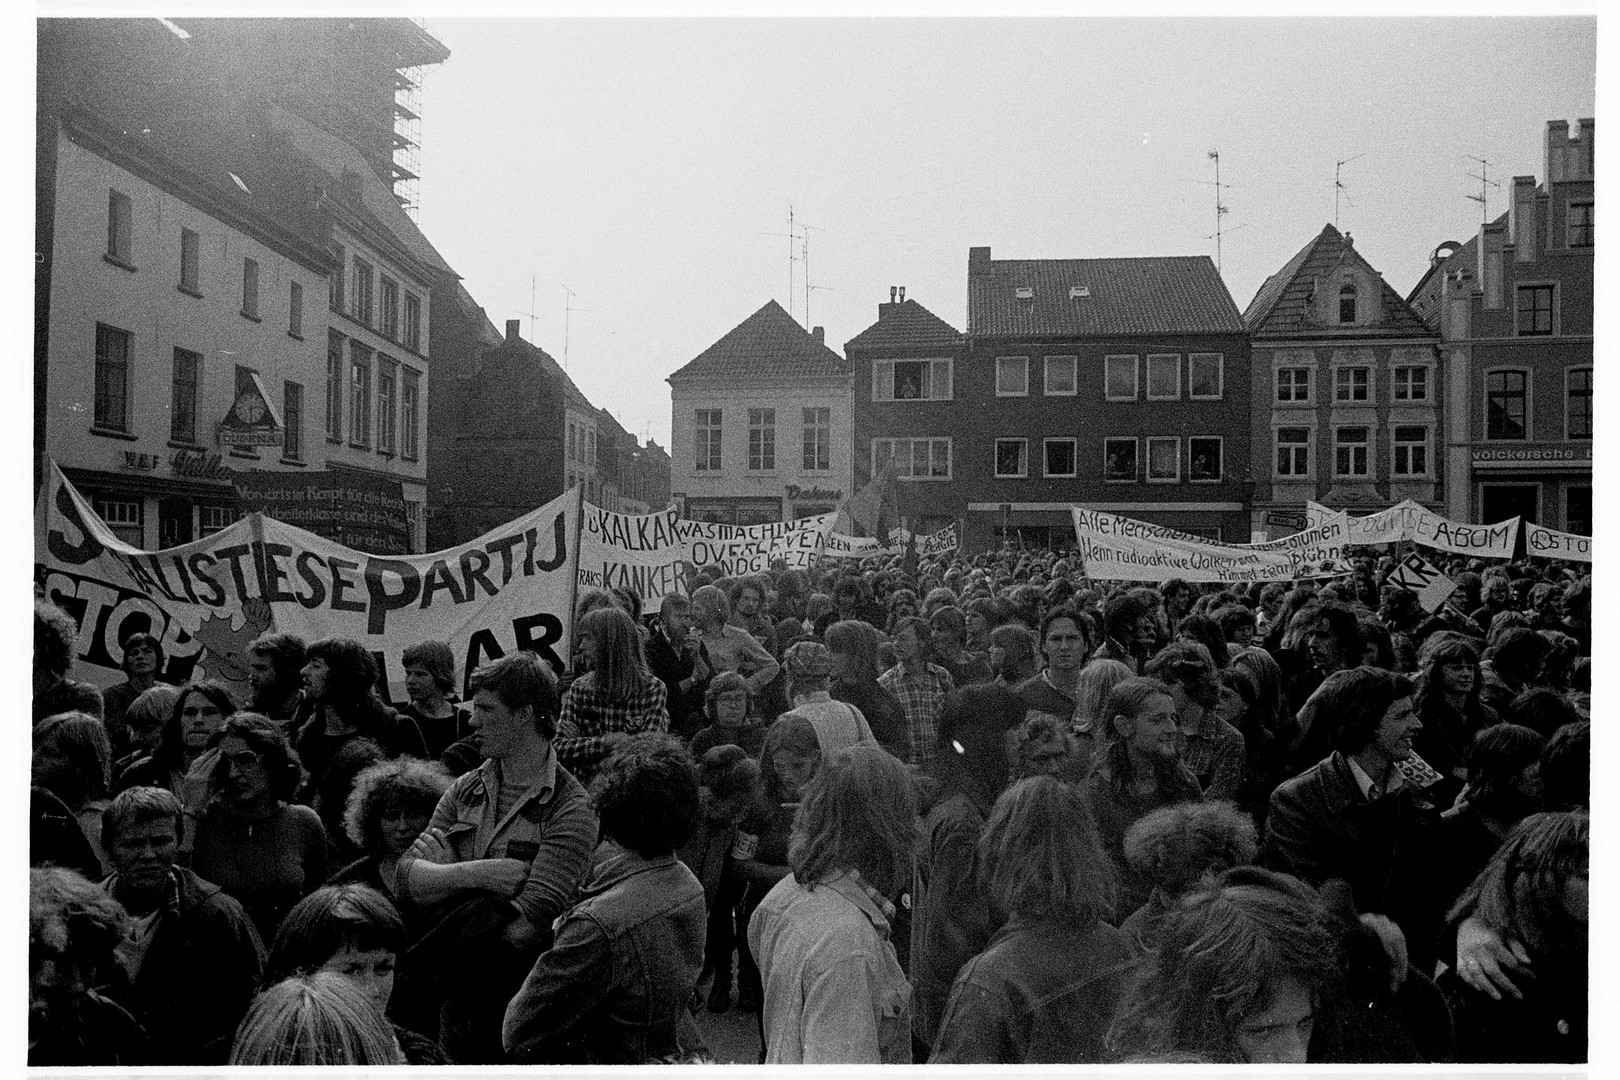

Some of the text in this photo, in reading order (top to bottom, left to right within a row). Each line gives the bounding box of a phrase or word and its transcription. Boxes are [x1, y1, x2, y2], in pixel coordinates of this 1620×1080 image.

[598, 509, 684, 551] KALKAR
[1079, 510, 1195, 544] Alle Menschen
[1363, 506, 1430, 536] DUITSE
[1432, 522, 1509, 550] A-BOM
[767, 550, 824, 569] KEZE
[1080, 535, 1113, 561] Wenn
[1116, 548, 1190, 570] radioaktive
[1190, 552, 1237, 570] Wolken
[365, 511, 567, 635] PARTIJ
[578, 560, 690, 600] RAKS KANKER
[1218, 568, 1258, 581] Himmel
